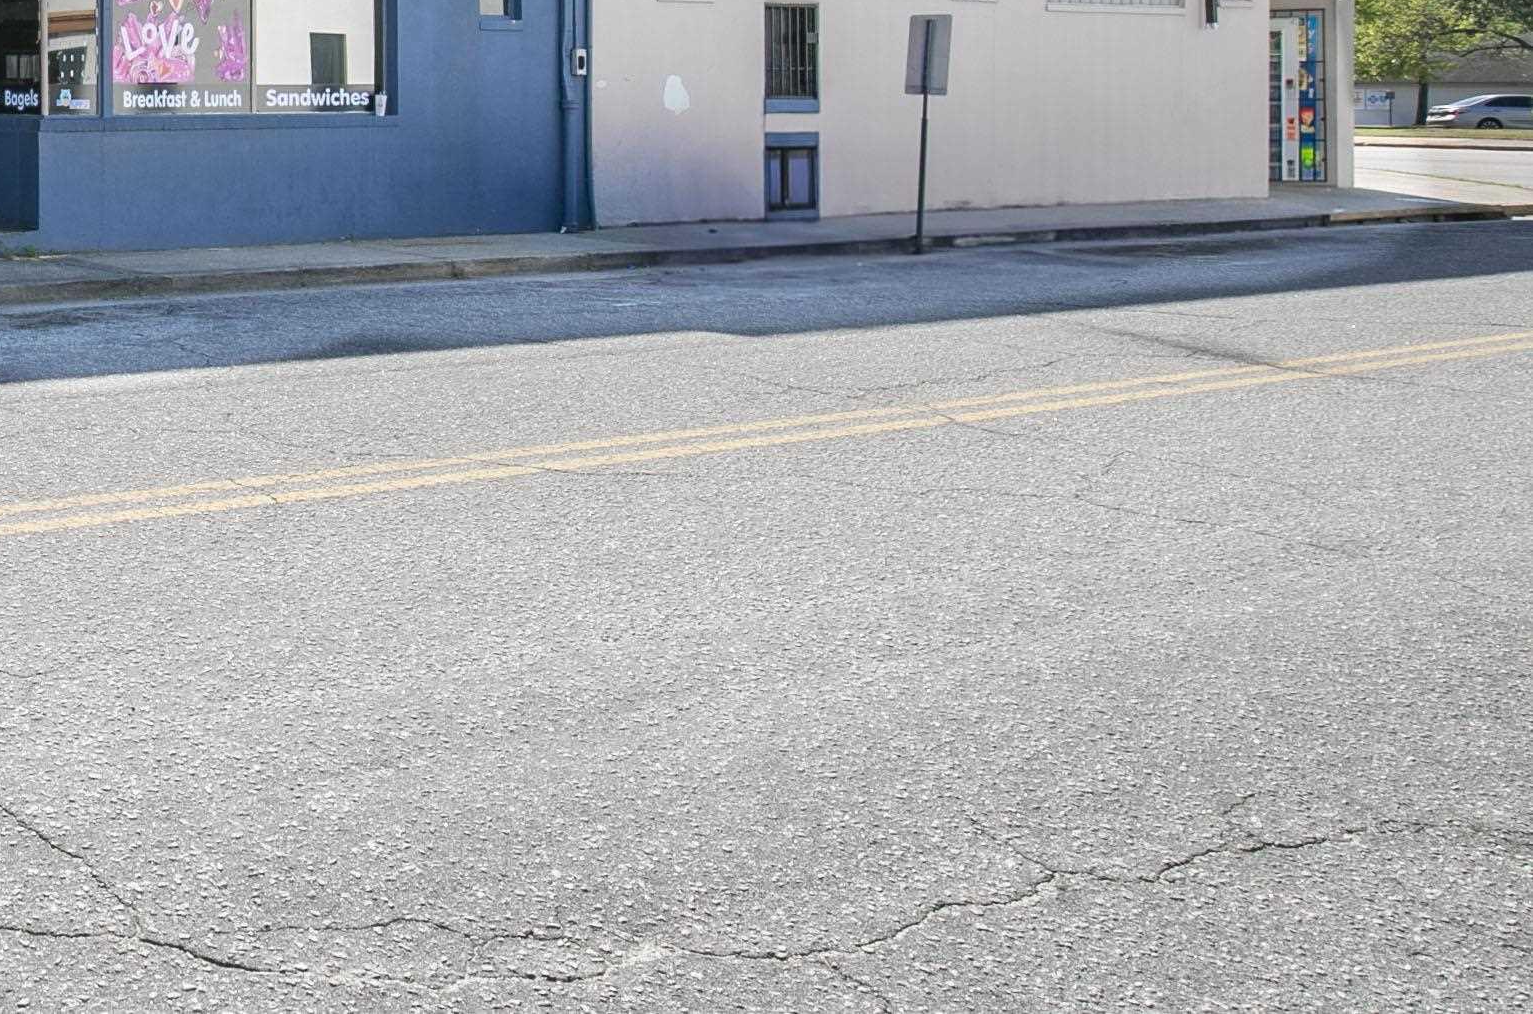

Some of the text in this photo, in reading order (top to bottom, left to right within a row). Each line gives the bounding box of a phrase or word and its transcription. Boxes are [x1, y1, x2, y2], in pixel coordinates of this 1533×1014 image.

[4, 88, 39, 110] Bagels
[123, 90, 242, 108] Breakfast & Lunch
[266, 89, 370, 107] Sandwiches
